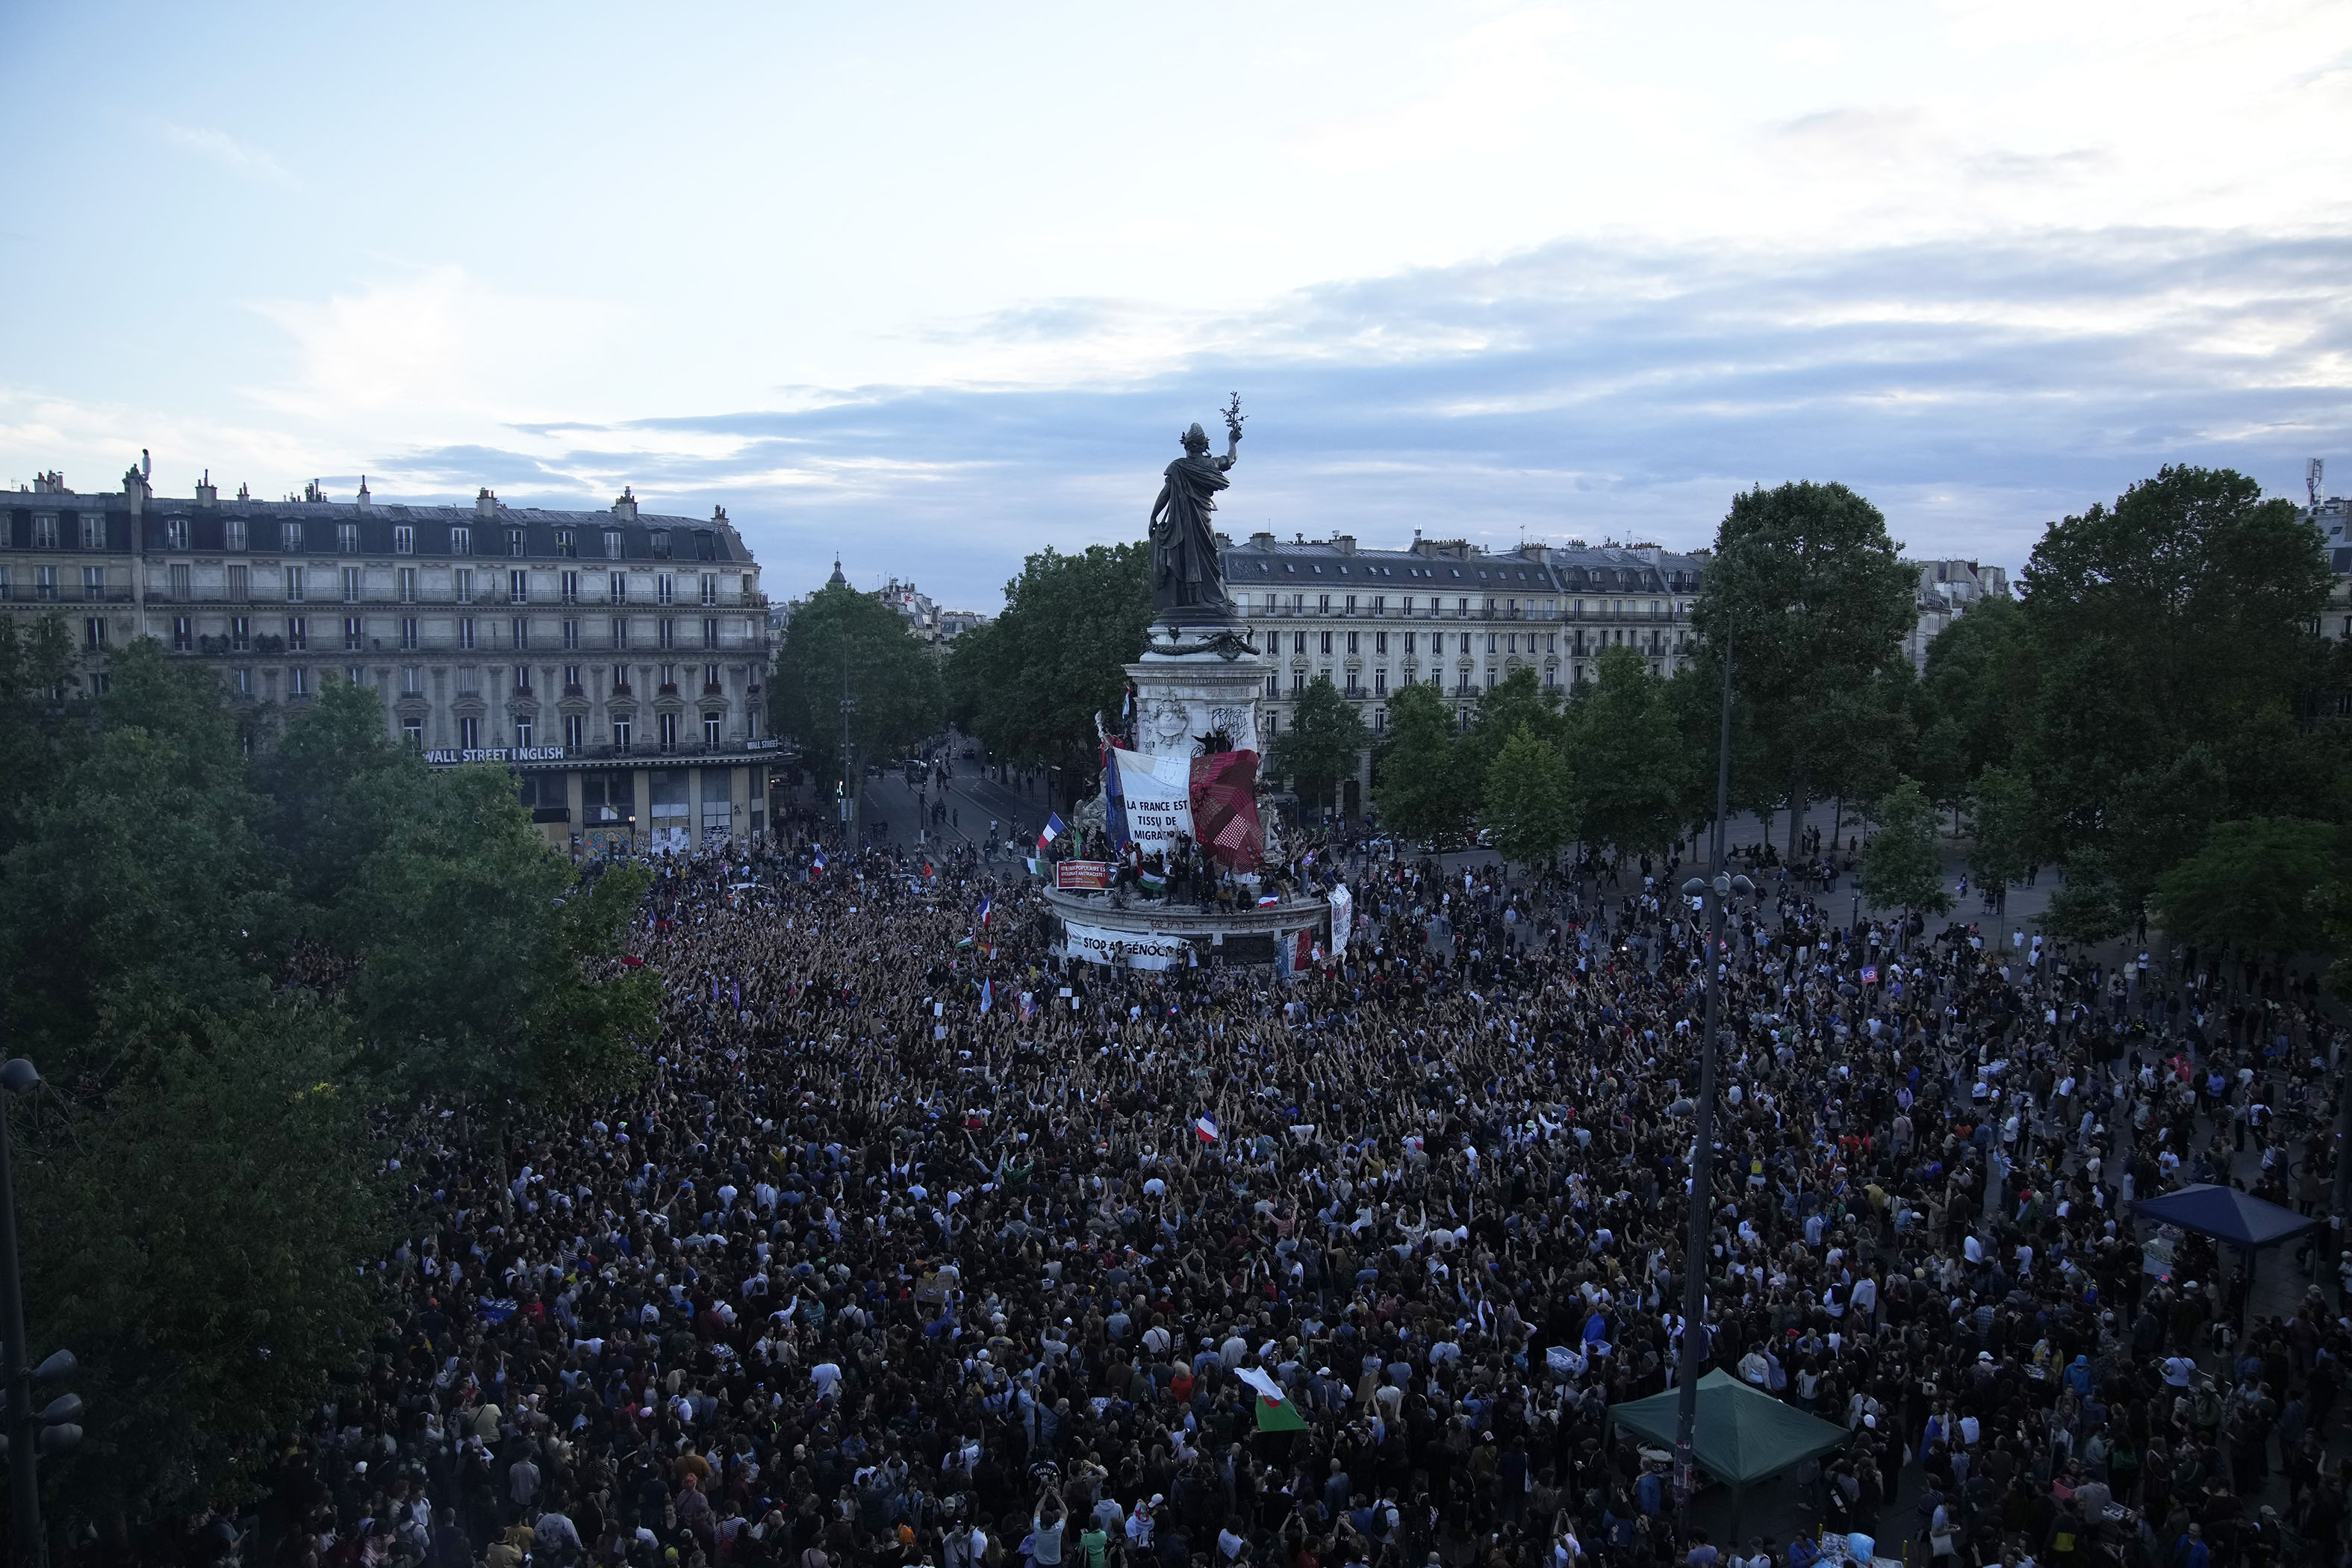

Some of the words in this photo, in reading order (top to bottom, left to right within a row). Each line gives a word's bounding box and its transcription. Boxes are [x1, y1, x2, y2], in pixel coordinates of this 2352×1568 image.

[747, 741, 760, 750] WALL
[424, 750, 458, 763] WALL
[462, 749, 508, 762] STREET
[1127, 800, 1136, 810] LA
[1139, 801, 1170, 811] FRANCE
[1174, 800, 1187, 810] EST
[1138, 816, 1161, 826] TISSU
[1166, 817, 1176, 825] DE
[1084, 938, 1107, 951] STOP
[1033, 1467, 1054, 1476] FRANCE
